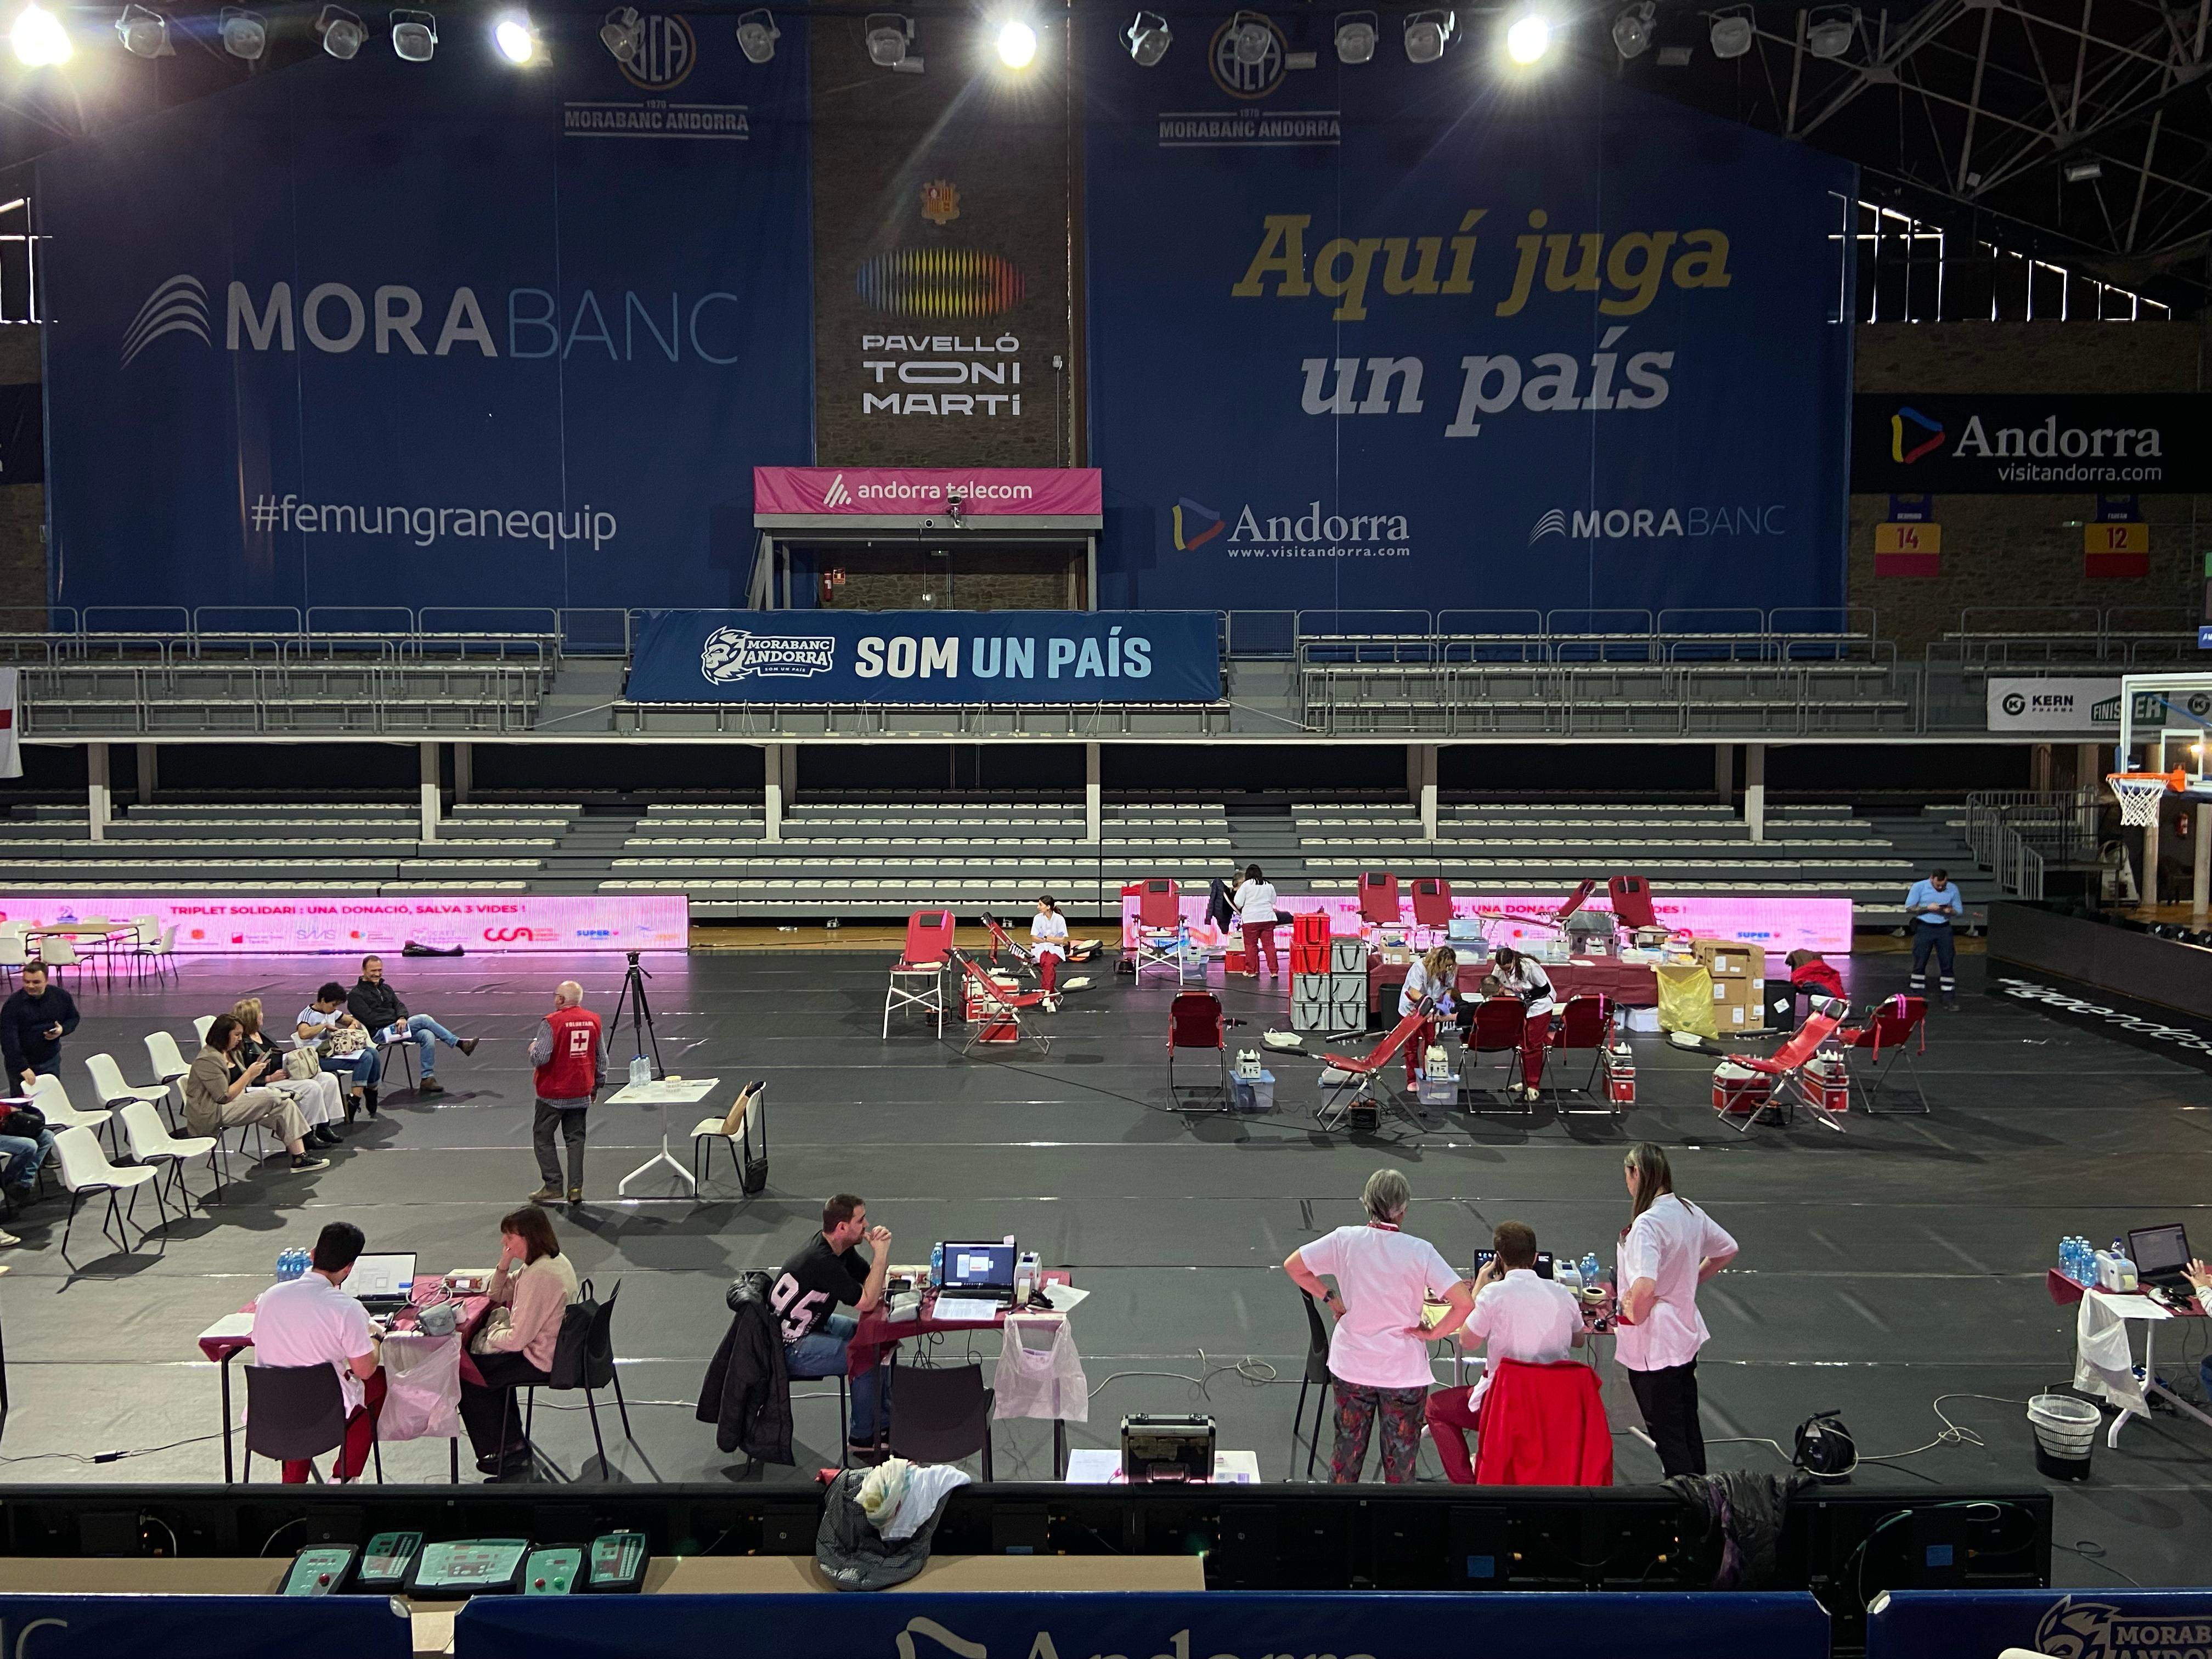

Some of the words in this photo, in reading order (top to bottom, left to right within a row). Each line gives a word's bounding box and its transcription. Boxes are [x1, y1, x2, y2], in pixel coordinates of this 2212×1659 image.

[565, 110, 662, 129] MORABANC
[665, 112, 749, 131] ANDORRA
[1159, 121, 1255, 138] MORABANC
[1259, 120, 1341, 137] ANDORRA
[1232, 209, 1488, 321] Aquí
[1495, 209, 1732, 317] juga
[862, 332, 1019, 352] PAVELLÓ
[862, 361, 1020, 384] TONI
[1300, 357, 1424, 415] un
[1444, 326, 1675, 437] país
[1952, 415, 2162, 458] Andorra
[1997, 462, 2162, 481] visitandorra.com
[857, 481, 941, 499] andorra
[946, 482, 1032, 499] telecom
[251, 494, 618, 550] #femungranequip
[1227, 501, 1410, 542] Andorra
[1897, 527, 1919, 549] 14
[2107, 527, 2128, 549] 12
[1227, 546, 1410, 558] www.visitandorra.com
[746, 640, 830, 650] MORABANC
[855, 636, 959, 678] SOM
[972, 637, 1034, 679] UN
[1047, 626, 1152, 678] PAÍS
[744, 650, 828, 666] ANDORRA
[2032, 695, 2074, 706] KERN
[2093, 693, 2161, 720] FINISER
[170, 906, 227, 915] TRIPLET
[230, 906, 296, 915] SOLIDARI
[307, 906, 338, 915] UNA
